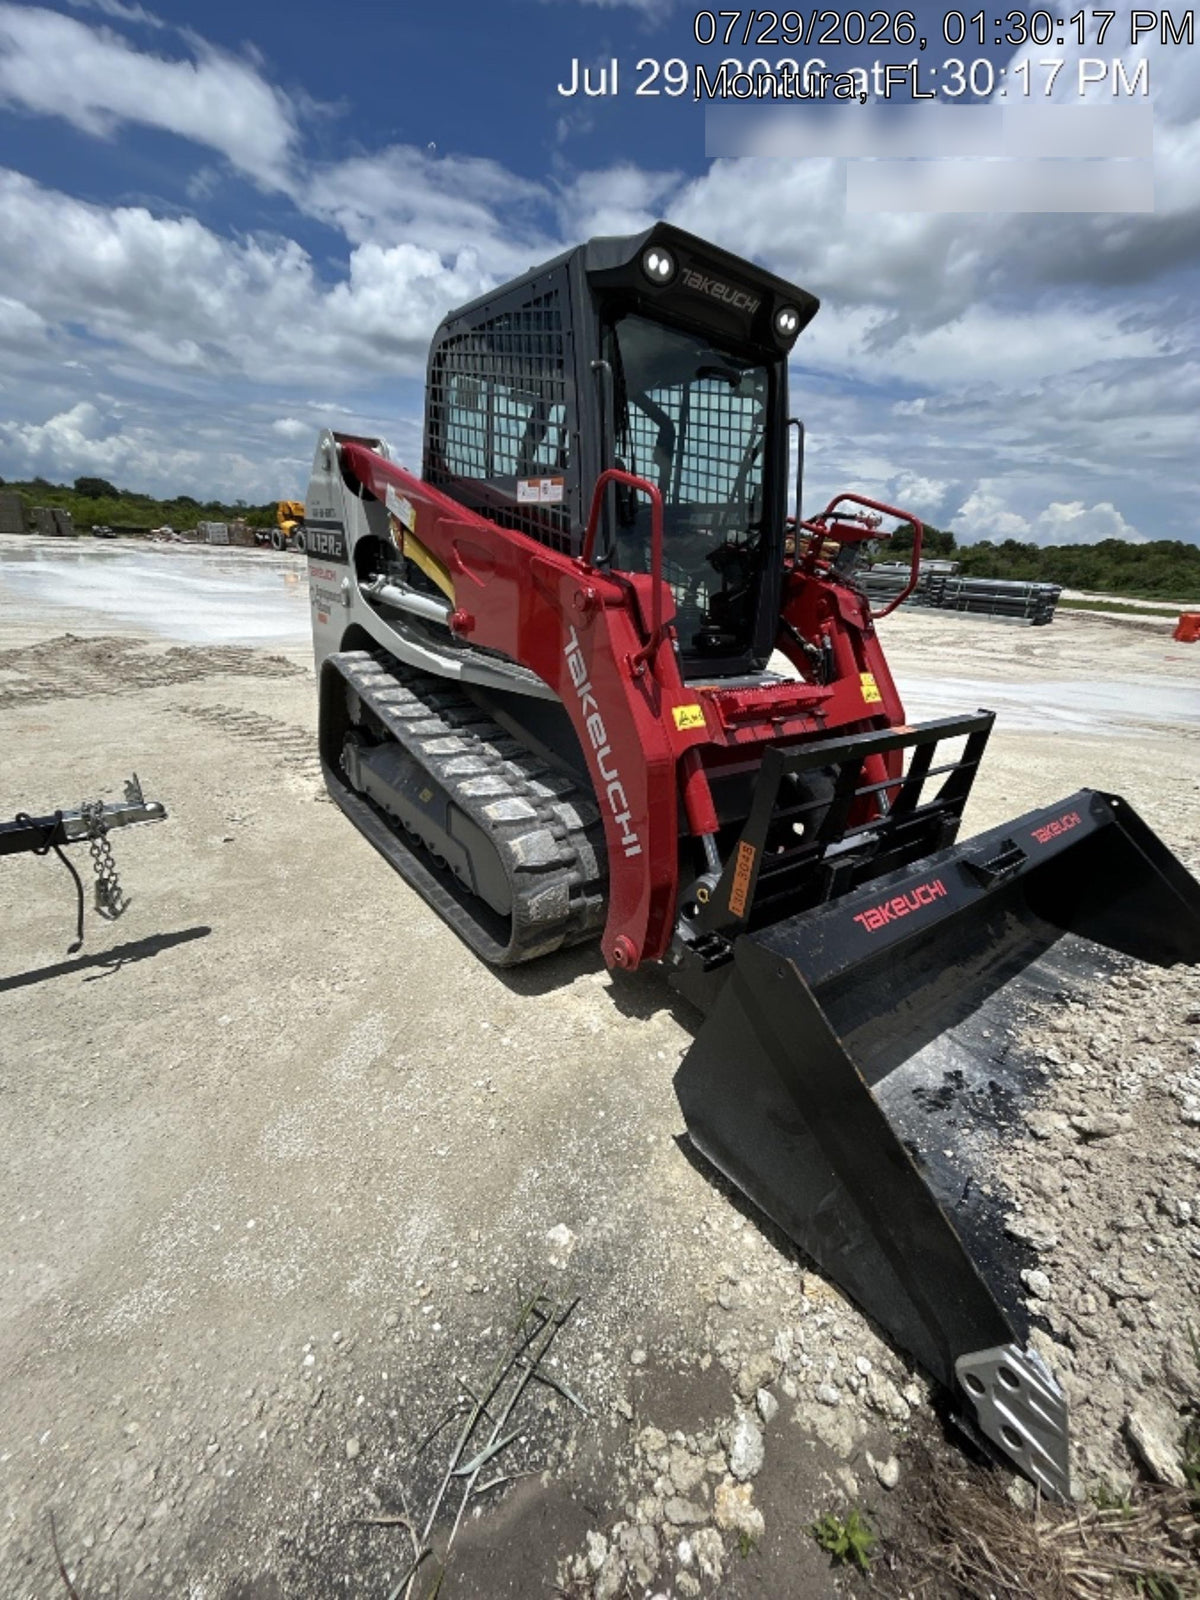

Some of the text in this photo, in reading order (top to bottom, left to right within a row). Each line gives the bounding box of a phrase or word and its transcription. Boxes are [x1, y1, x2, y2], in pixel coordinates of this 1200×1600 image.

[682, 268, 761, 314] TAKEUCHI
[564, 624, 643, 858] TAKEUCHI
[1031, 812, 1082, 844] TAKEUCHI
[853, 879, 948, 933] TAKEUCHI
